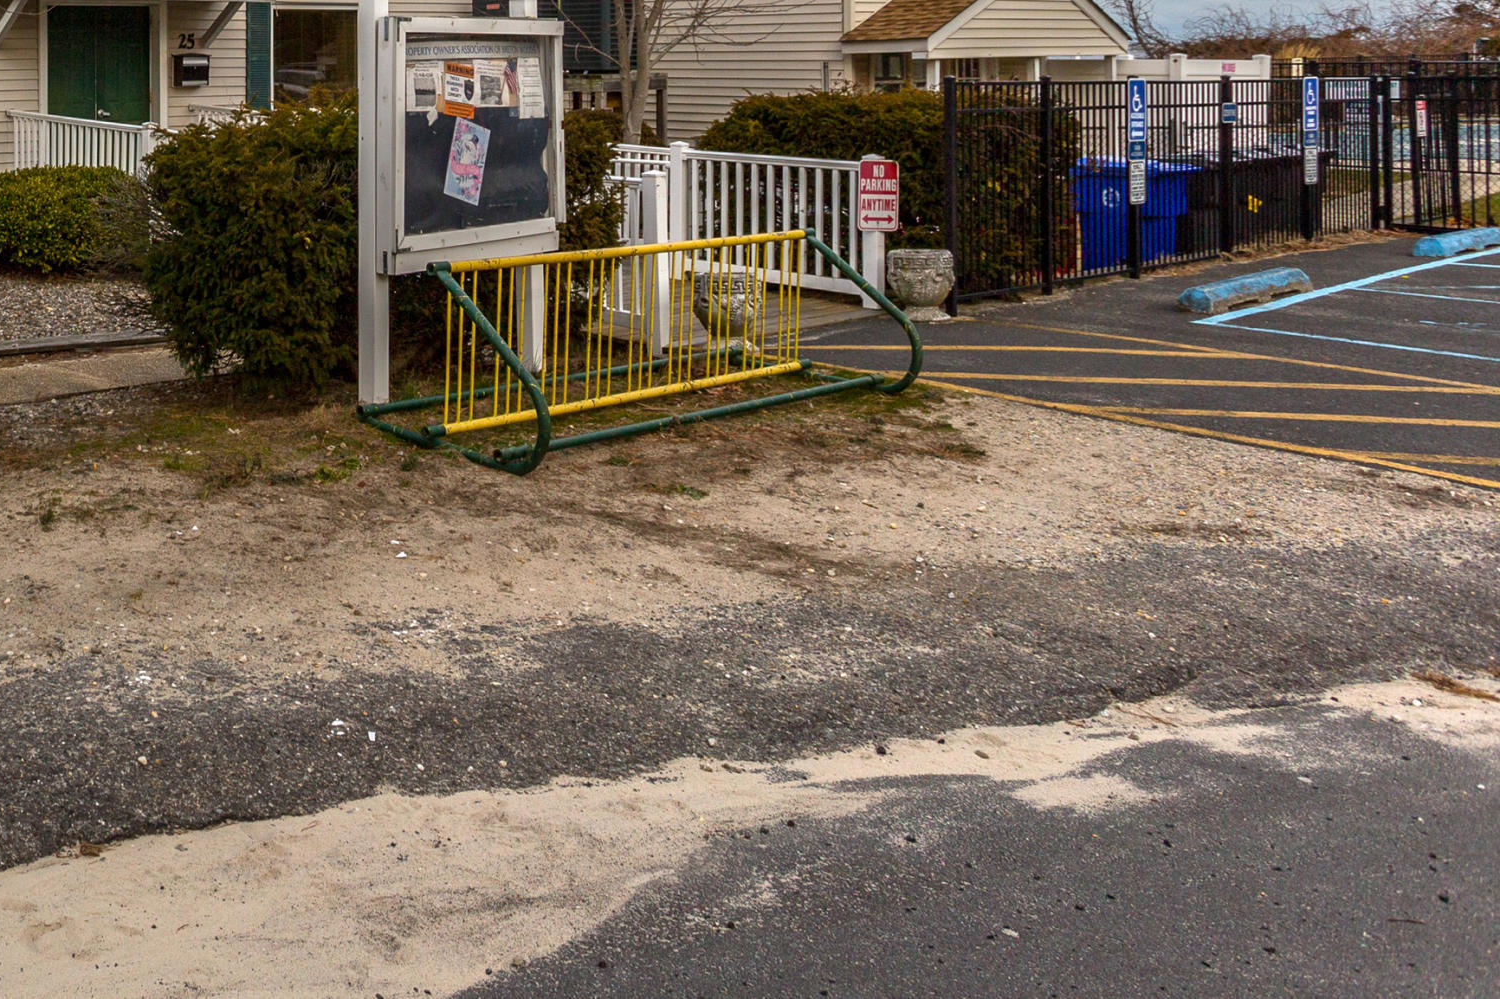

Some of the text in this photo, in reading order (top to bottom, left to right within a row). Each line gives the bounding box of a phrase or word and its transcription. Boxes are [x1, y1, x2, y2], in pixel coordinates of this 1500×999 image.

[178, 33, 195, 49] 25
[447, 63, 474, 76] WARNING
[873, 165, 885, 178] NO
[860, 179, 897, 192] PARKING
[861, 198, 896, 211] ANYTIME
